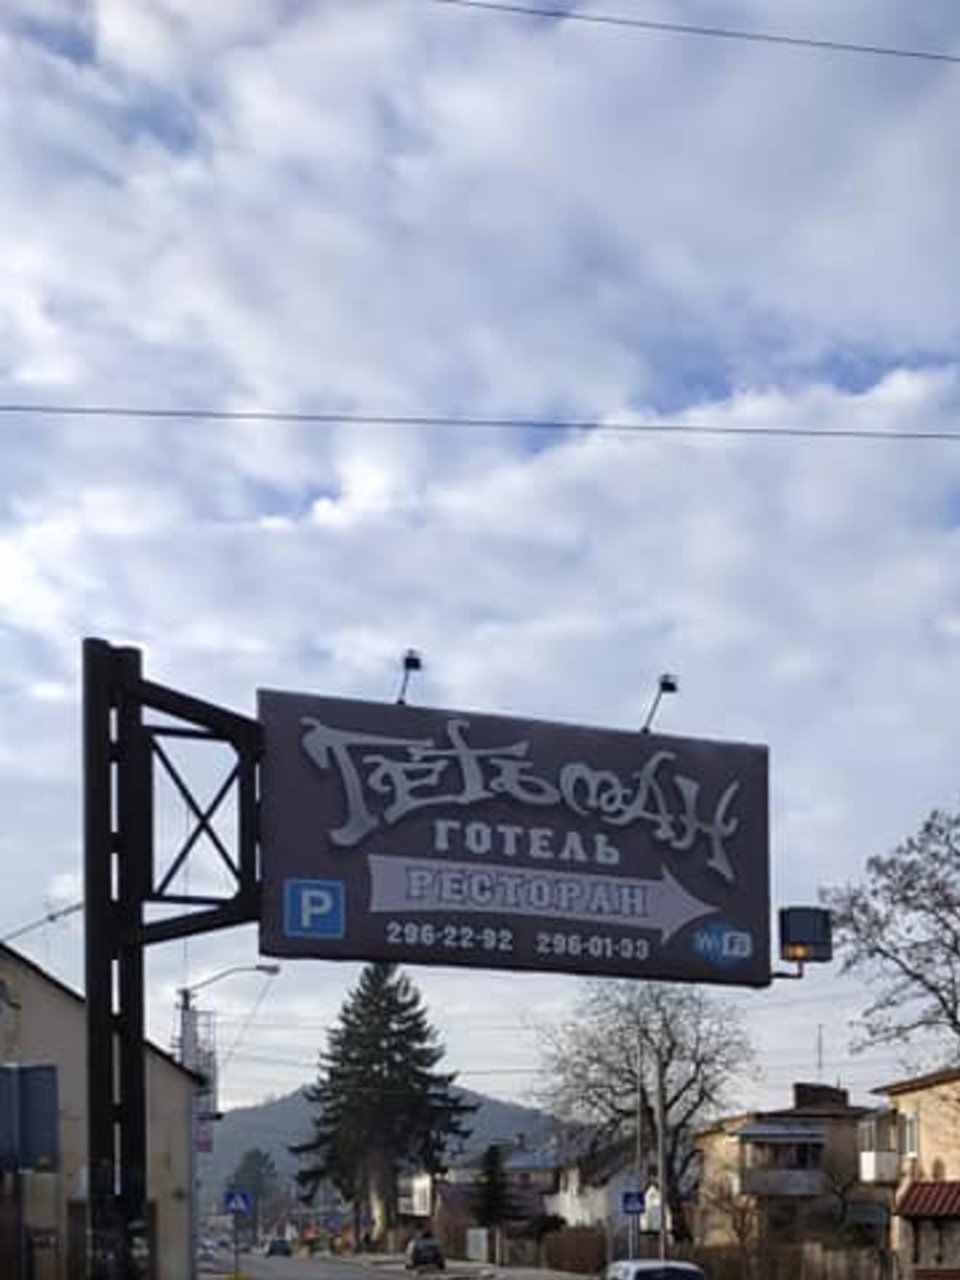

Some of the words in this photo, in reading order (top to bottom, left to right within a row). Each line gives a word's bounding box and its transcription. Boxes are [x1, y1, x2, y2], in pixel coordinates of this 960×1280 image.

[434, 819, 620, 865] ГОТЕЛЬ
[301, 889, 333, 928] P
[407, 870, 649, 917] РЕСТОРАН
[386, 921, 513, 951] 296-22-92
